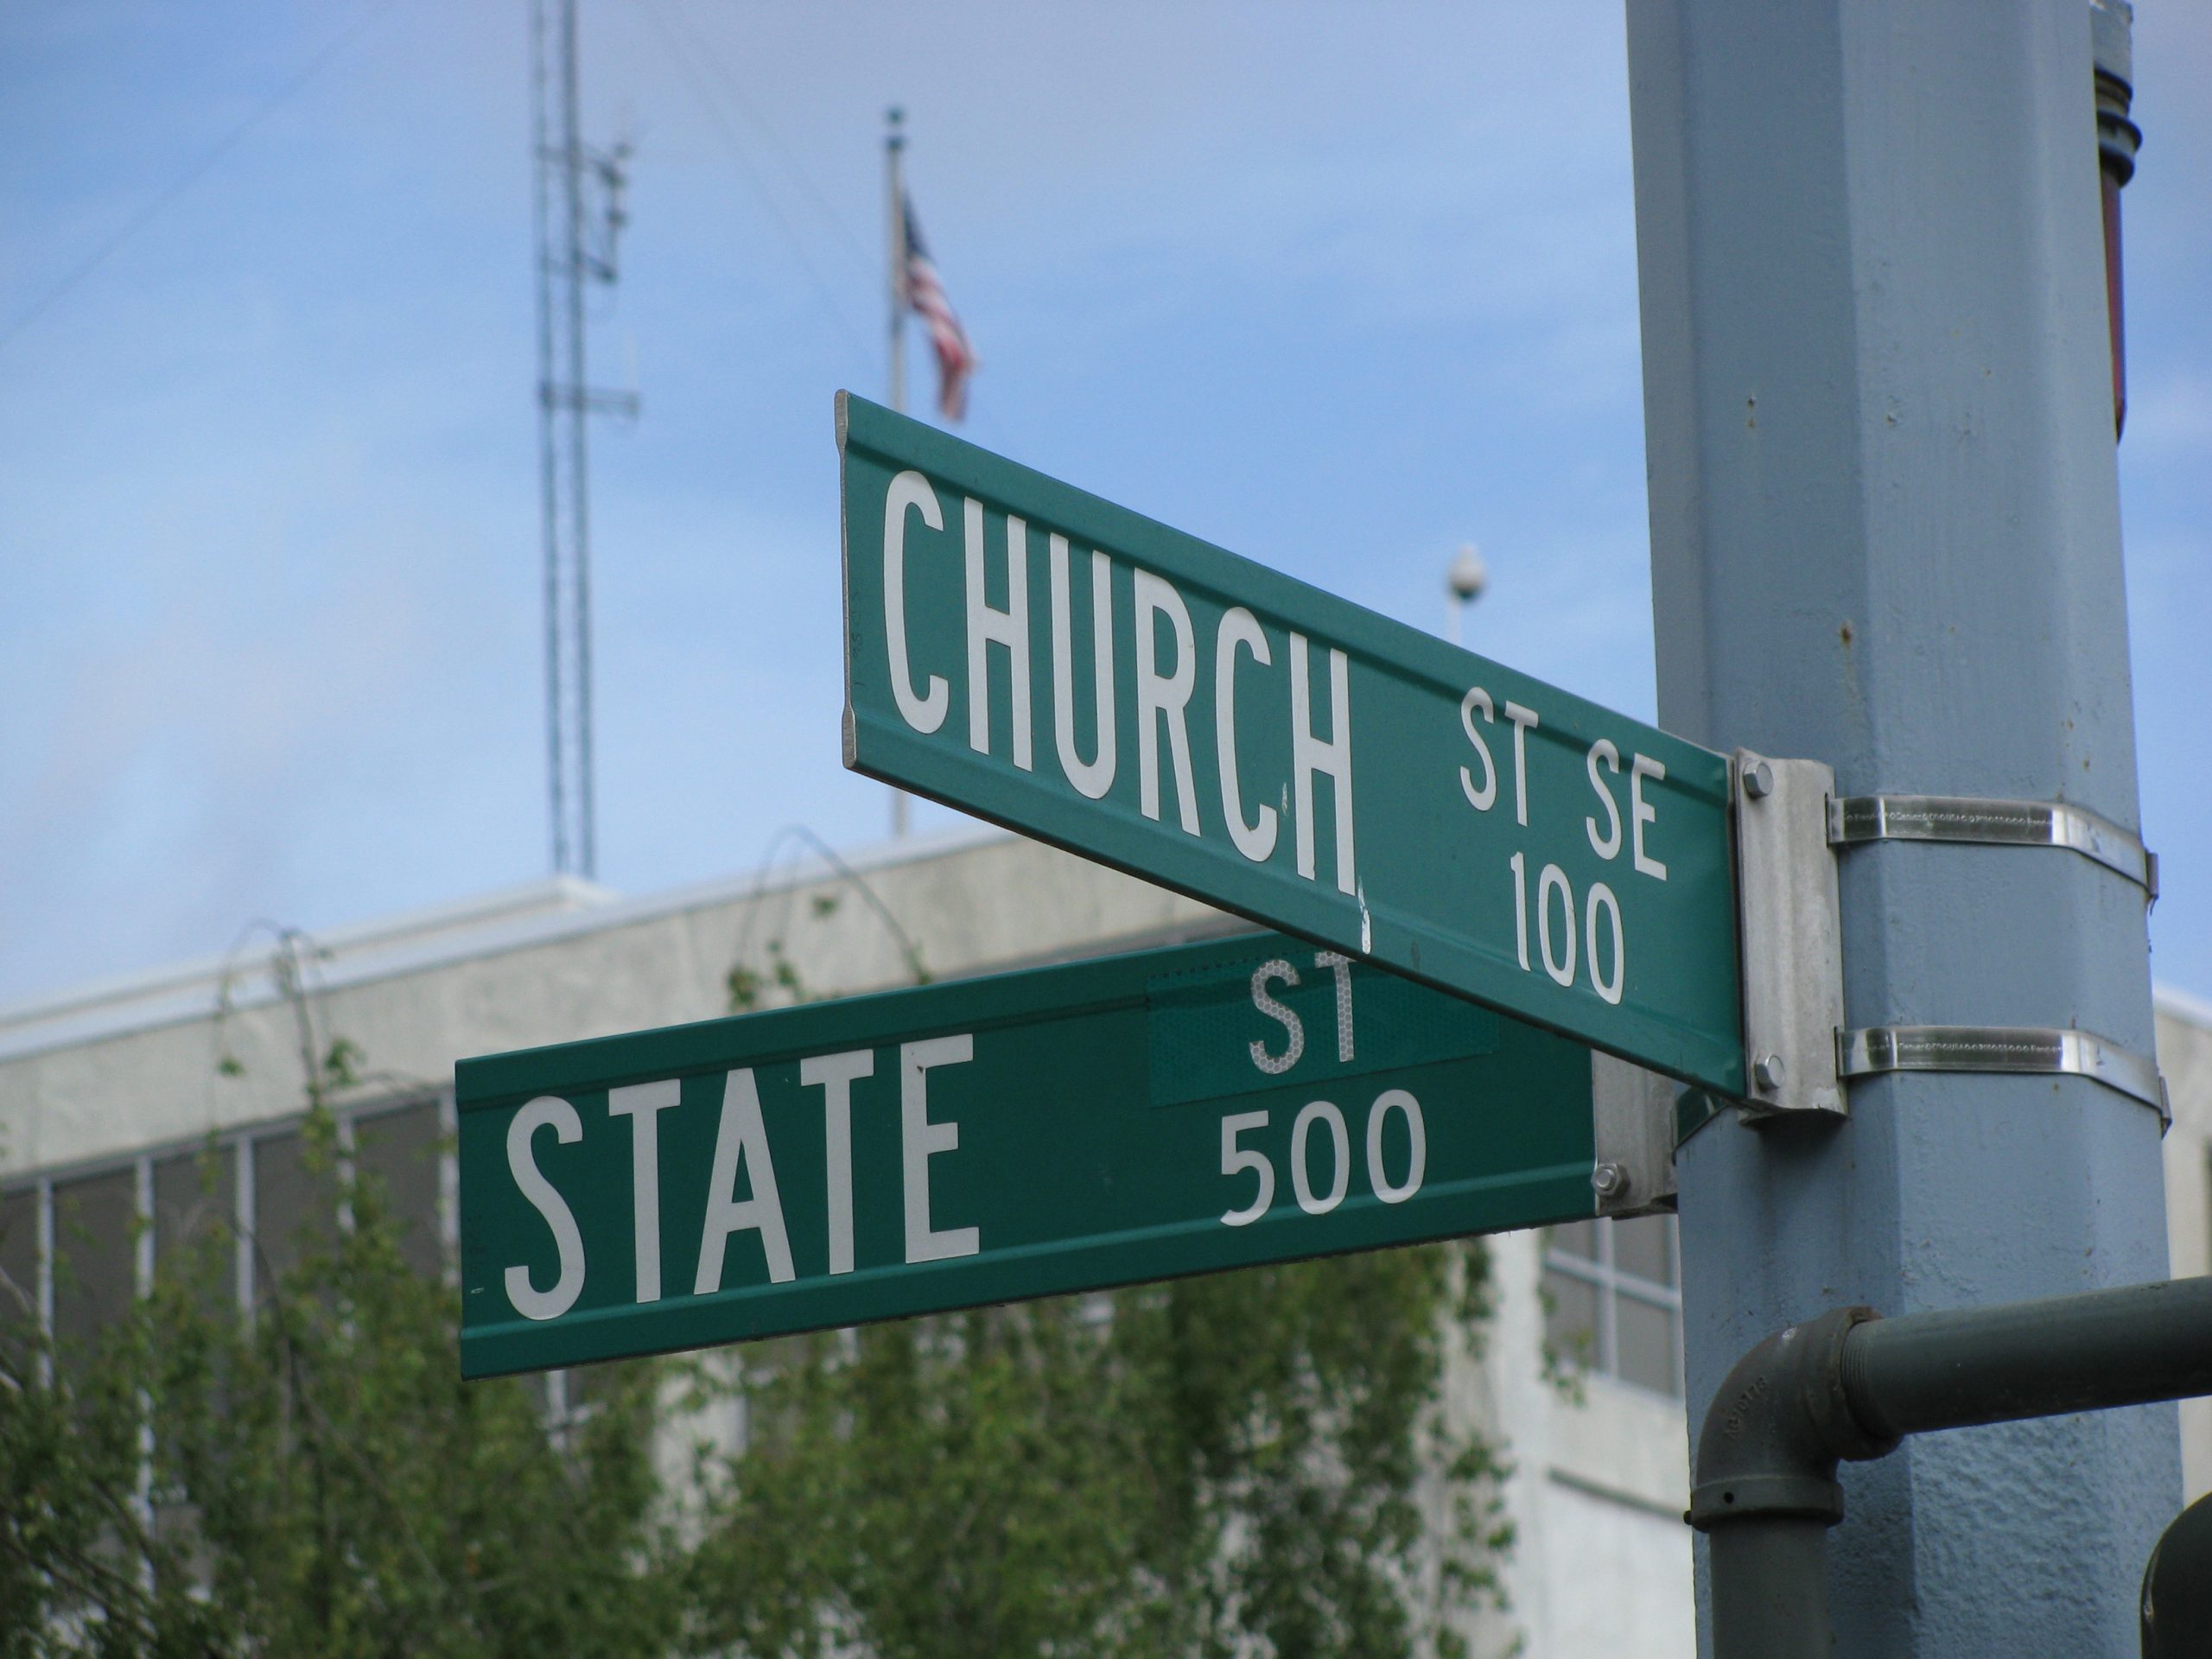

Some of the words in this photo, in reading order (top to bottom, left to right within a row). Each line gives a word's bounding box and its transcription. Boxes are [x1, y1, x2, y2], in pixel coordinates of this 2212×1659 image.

[883, 470, 1356, 897] CHURCH
[1459, 686, 1539, 827] ST
[1586, 738, 1668, 881] SE
[1510, 851, 1624, 1005] 100
[505, 1033, 980, 1320] STATE
[1249, 951, 1357, 1075] ST
[1219, 1089, 1427, 1227] 500
